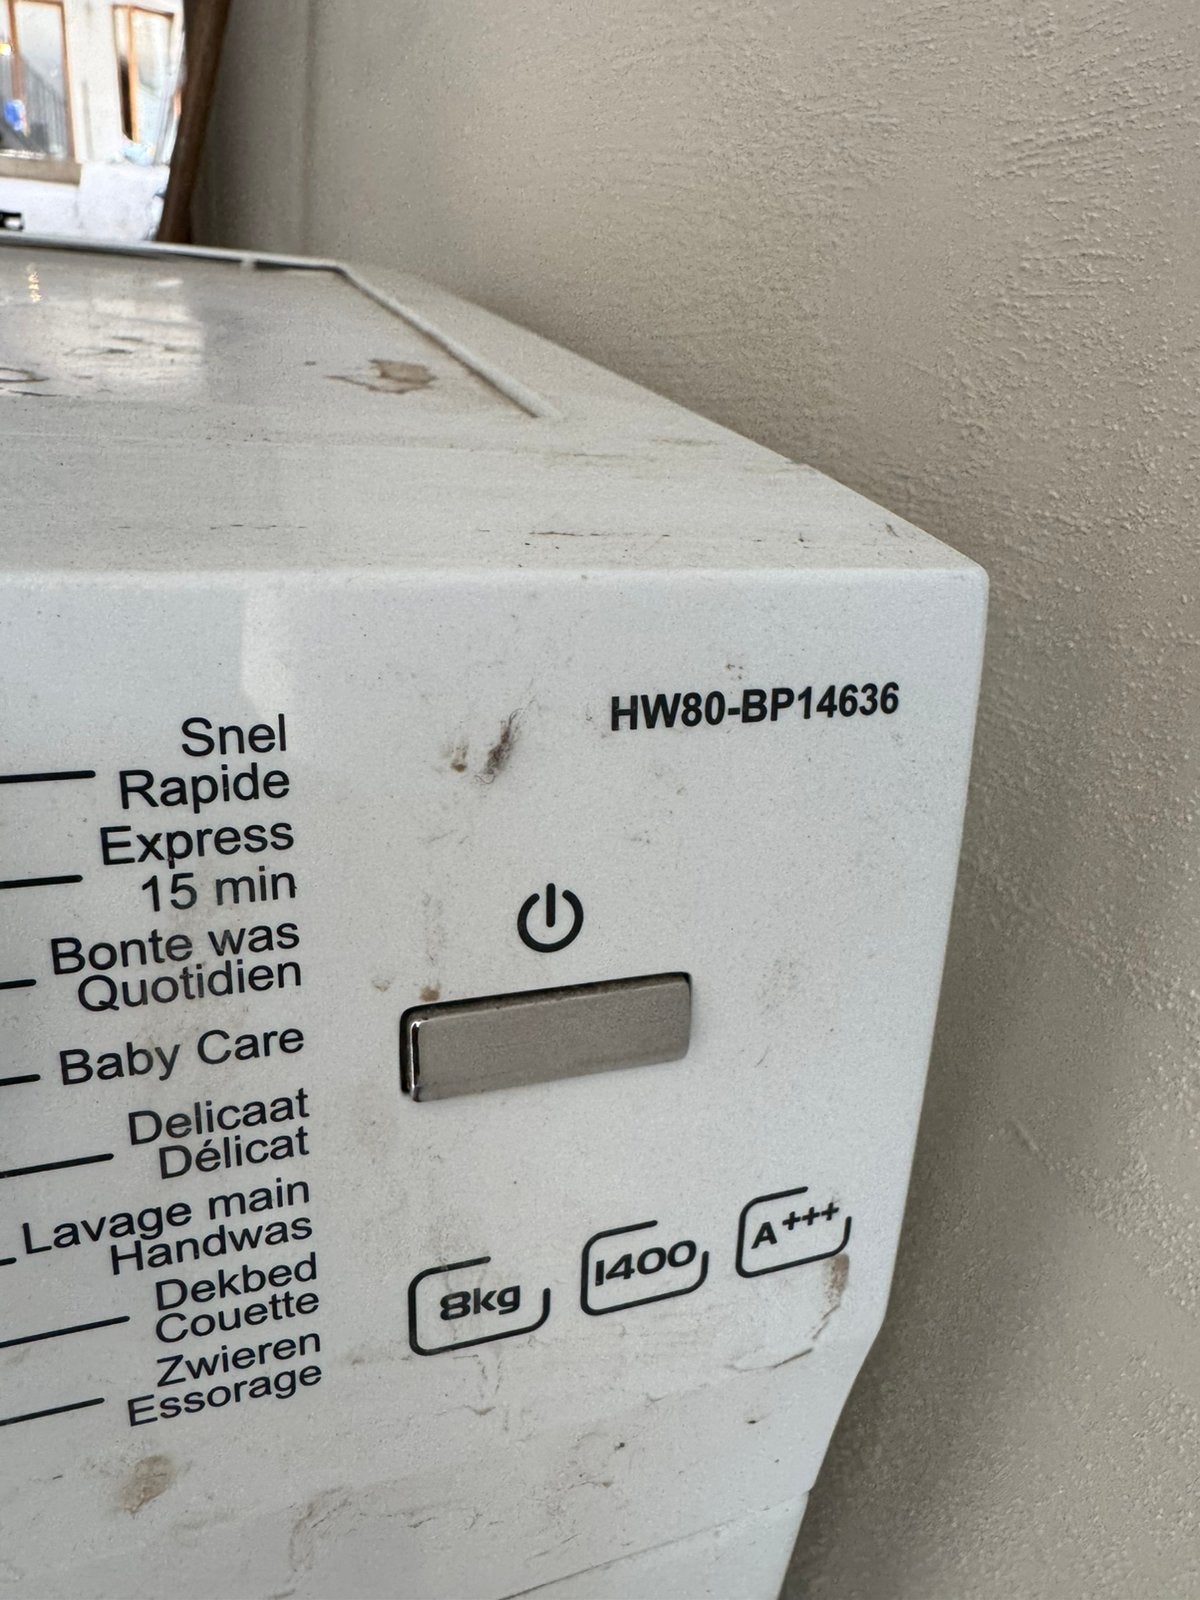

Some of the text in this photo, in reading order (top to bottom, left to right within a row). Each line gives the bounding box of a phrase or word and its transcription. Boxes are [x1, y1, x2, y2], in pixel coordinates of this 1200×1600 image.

[610, 681, 900, 732] HW80-BP14636
[180, 712, 287, 758] Snel
[118, 761, 290, 815] Rapide
[99, 822, 295, 870] Express
[141, 865, 298, 913] 15 min
[50, 922, 300, 976] Bonte was
[77, 958, 302, 1013] Quotidien
[58, 1027, 305, 1086] Baby Care
[127, 1087, 311, 1146] Delicaat
[158, 1125, 310, 1180] Délicat
[21, 1177, 310, 1255] Lavage main
[750, 1201, 840, 1250] A+++
[110, 1216, 313, 1276] Handwas
[594, 1239, 698, 1287] 1400
[155, 1251, 317, 1312] Dekbed
[439, 1284, 521, 1321] 8kg
[155, 1290, 320, 1344] Couette
[156, 1332, 321, 1388] Zwieren
[127, 1365, 322, 1427] Essorage
